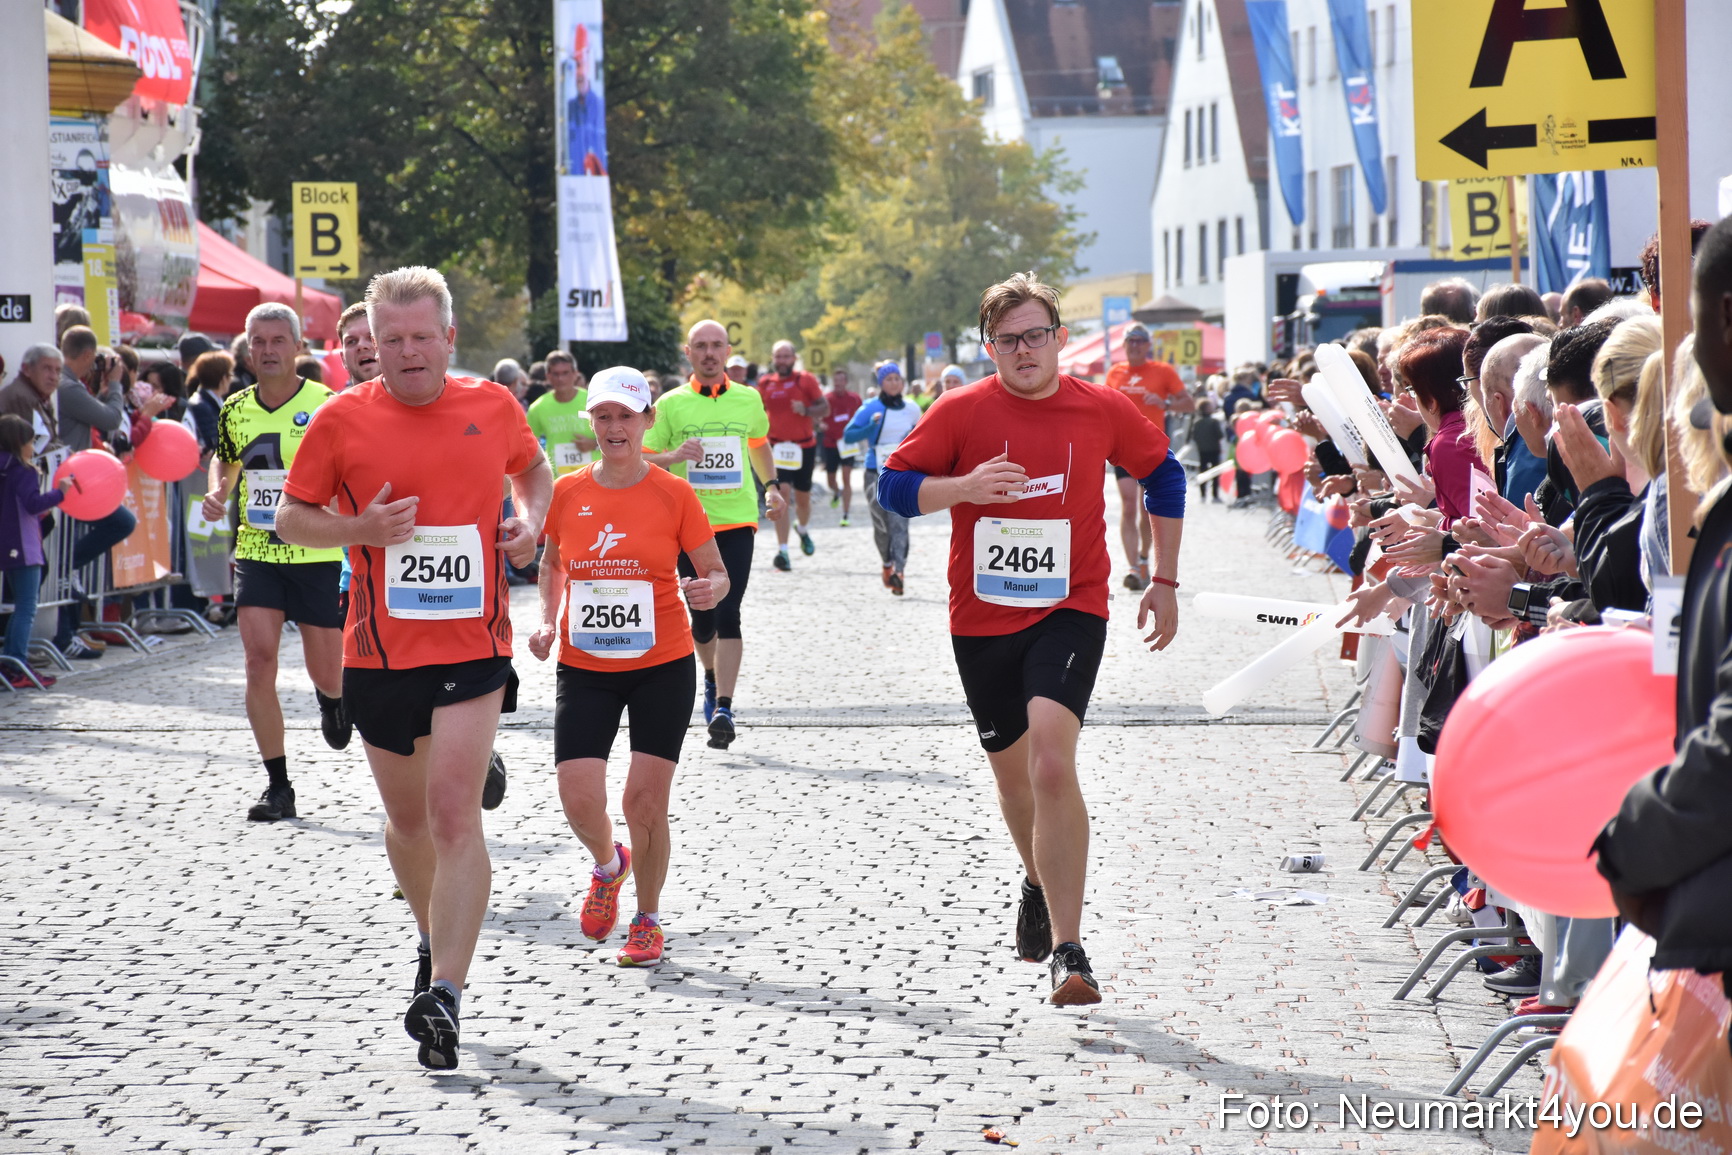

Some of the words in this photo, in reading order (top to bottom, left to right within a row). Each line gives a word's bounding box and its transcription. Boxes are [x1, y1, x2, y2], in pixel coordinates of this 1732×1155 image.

[1469, 0, 1628, 88] A
[300, 187, 350, 205] Block
[1466, 191, 1501, 238] B
[310, 212, 342, 257] B
[727, 321, 742, 346] C
[811, 348, 824, 367] D
[1184, 340, 1198, 358] D
[621, 383, 641, 393] up!
[253, 488, 283, 508] 267
[424, 535, 458, 543] BOCK
[1011, 527, 1043, 535] BOCK
[569, 559, 640, 571] funrunners
[988, 545, 1056, 573] 2464
[400, 555, 471, 583] 2540
[591, 567, 649, 577] neumarkt
[1003, 581, 1038, 592] Manuel
[418, 593, 454, 603] Werner
[581, 604, 642, 629] 2564
[1256, 613, 1299, 626] swn
[594, 636, 631, 646] Angelika
